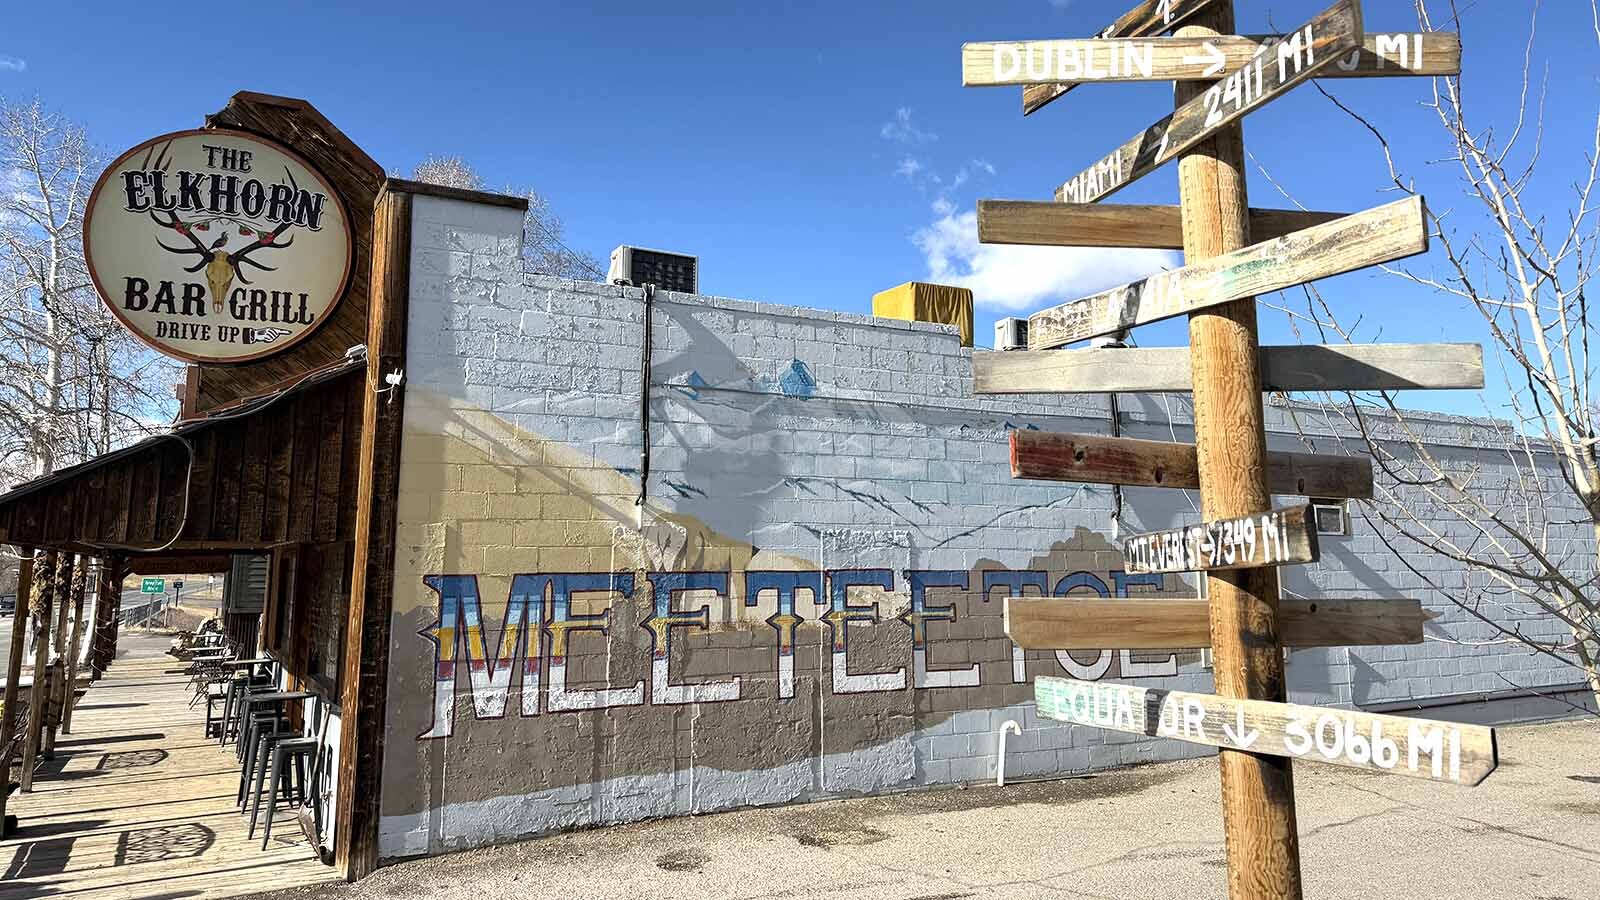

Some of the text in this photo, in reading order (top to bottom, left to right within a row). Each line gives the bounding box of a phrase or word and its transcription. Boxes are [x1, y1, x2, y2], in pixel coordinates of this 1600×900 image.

[994, 43, 1153, 80] DUBLIN
[1375, 34, 1424, 70] MI
[1064, 148, 1123, 203] MIAMI
[1203, 64, 1264, 128] 2411
[1277, 24, 1315, 84] MI
[202, 144, 252, 173] THE
[121, 169, 327, 231] ELKHORN
[123, 276, 315, 325] BAR GRILL
[155, 320, 240, 343] DRIVE UP
[1053, 686, 1461, 784] EQUAOR 3066 MI
